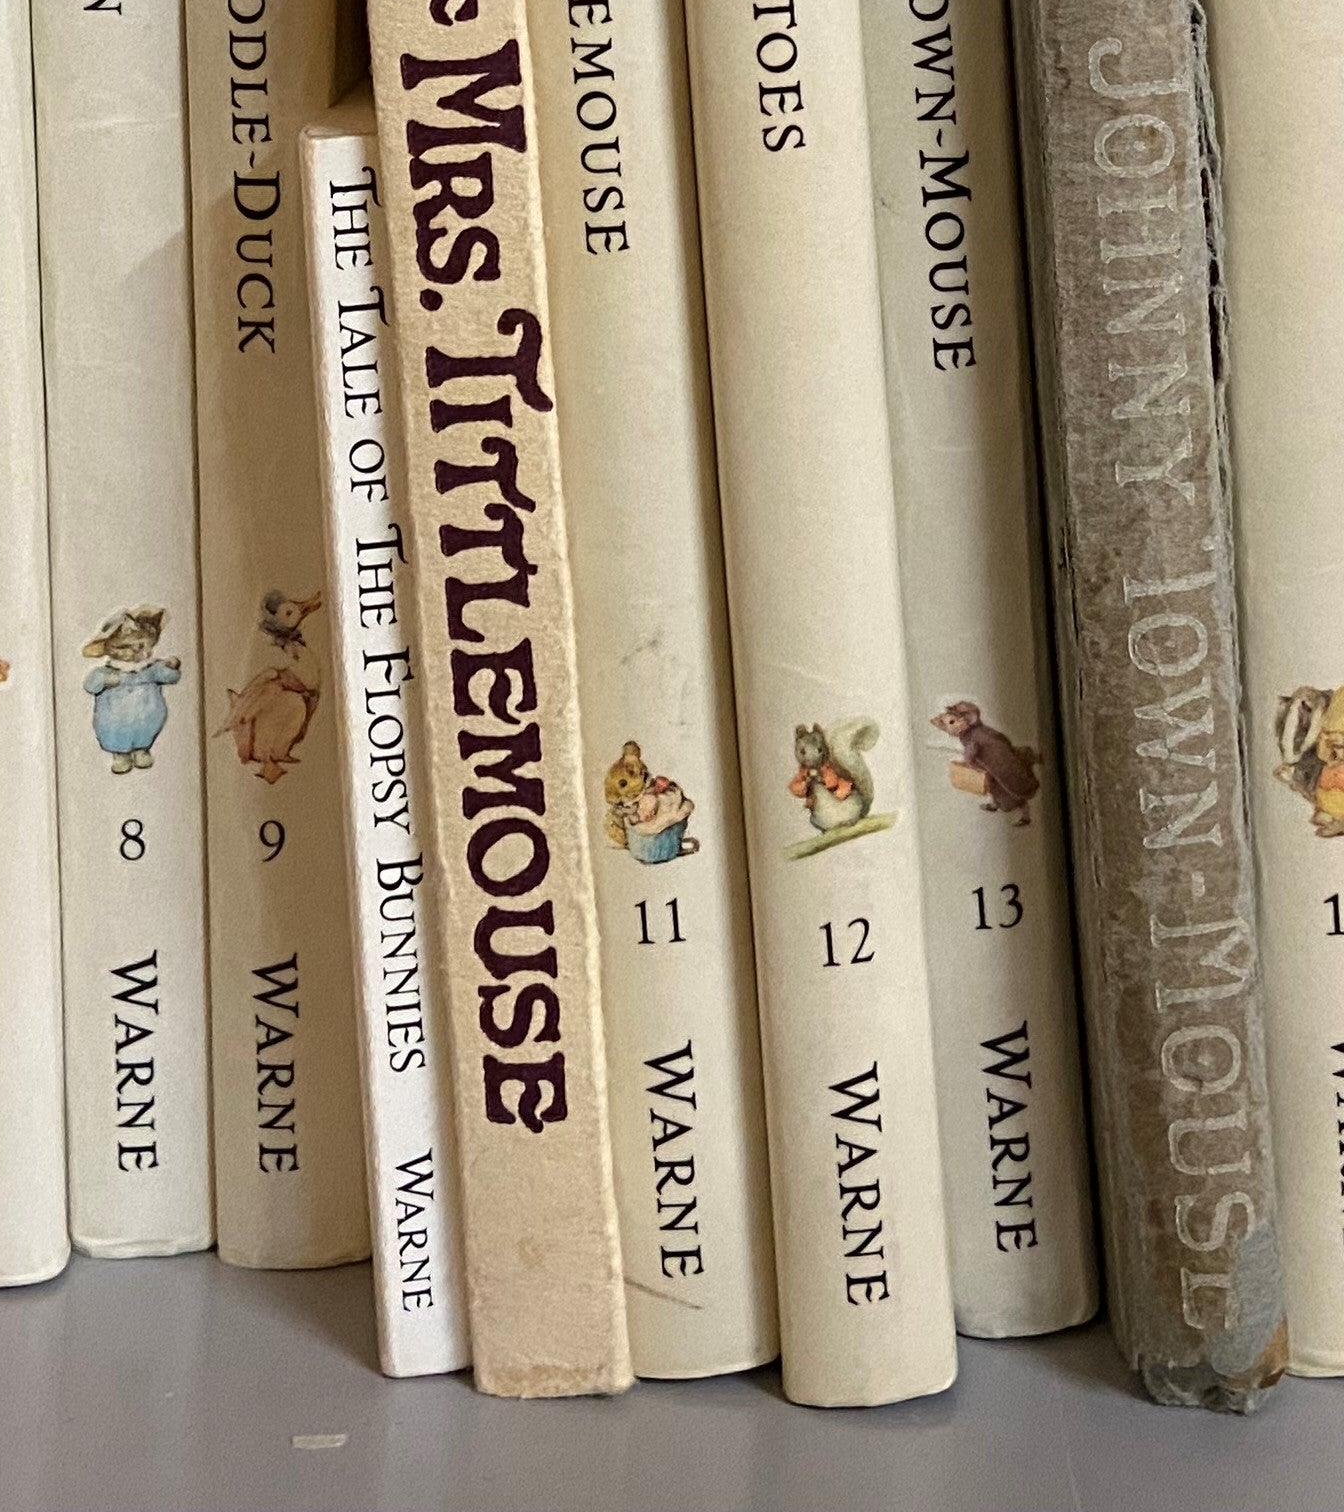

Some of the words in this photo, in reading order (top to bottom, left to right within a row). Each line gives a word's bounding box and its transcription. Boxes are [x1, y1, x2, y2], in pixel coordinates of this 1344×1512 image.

[328, 166, 377, 272] THE
[400, 38, 527, 312] MRS.
[337, 287, 387, 420] TALE
[1087, 38, 1196, 504] JOHNNY
[348, 438, 389, 504] OF
[353, 521, 411, 631] THE
[361, 644, 413, 835] FLOPSY
[427, 307, 567, 1134] TITTLEMOUSE
[118, 818, 146, 861] 8
[259, 818, 286, 862] 9
[634, 897, 686, 946] 11
[971, 885, 1023, 931] 13
[376, 852, 428, 1074] BUNNIES
[819, 915, 875, 970] 12
[108, 949, 159, 1174] WARNE
[251, 952, 300, 1177] WARNE
[979, 1021, 1039, 1253] WARNE
[393, 1148, 436, 1313] WARNE
[643, 1039, 705, 1279] WARNE
[827, 1061, 890, 1307] WARNE
